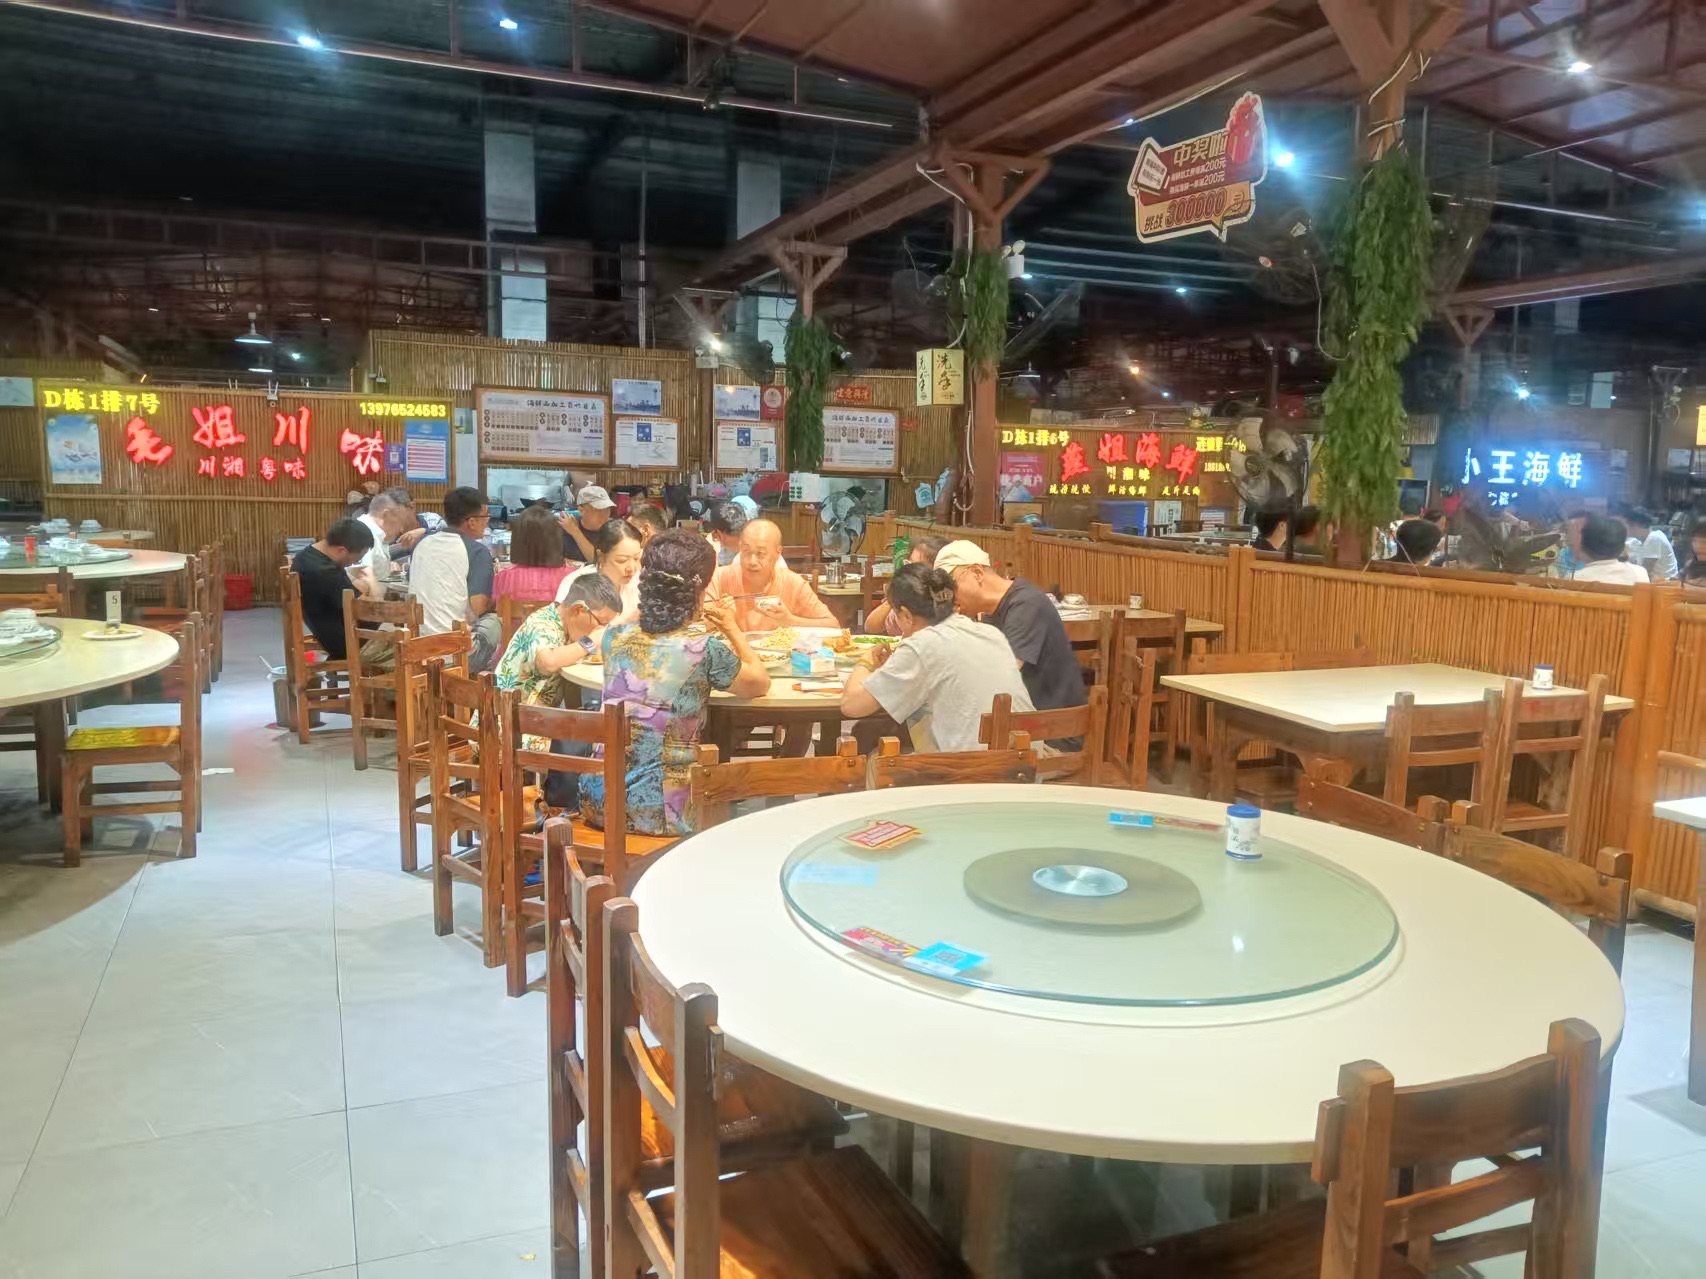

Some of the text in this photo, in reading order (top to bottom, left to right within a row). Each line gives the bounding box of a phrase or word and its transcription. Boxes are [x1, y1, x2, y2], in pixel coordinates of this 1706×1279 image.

[43, 388, 161, 415] D栋1排7号
[1001, 429, 1070, 447] D栋1排6号
[1461, 447, 1583, 488] 小王海鲜
